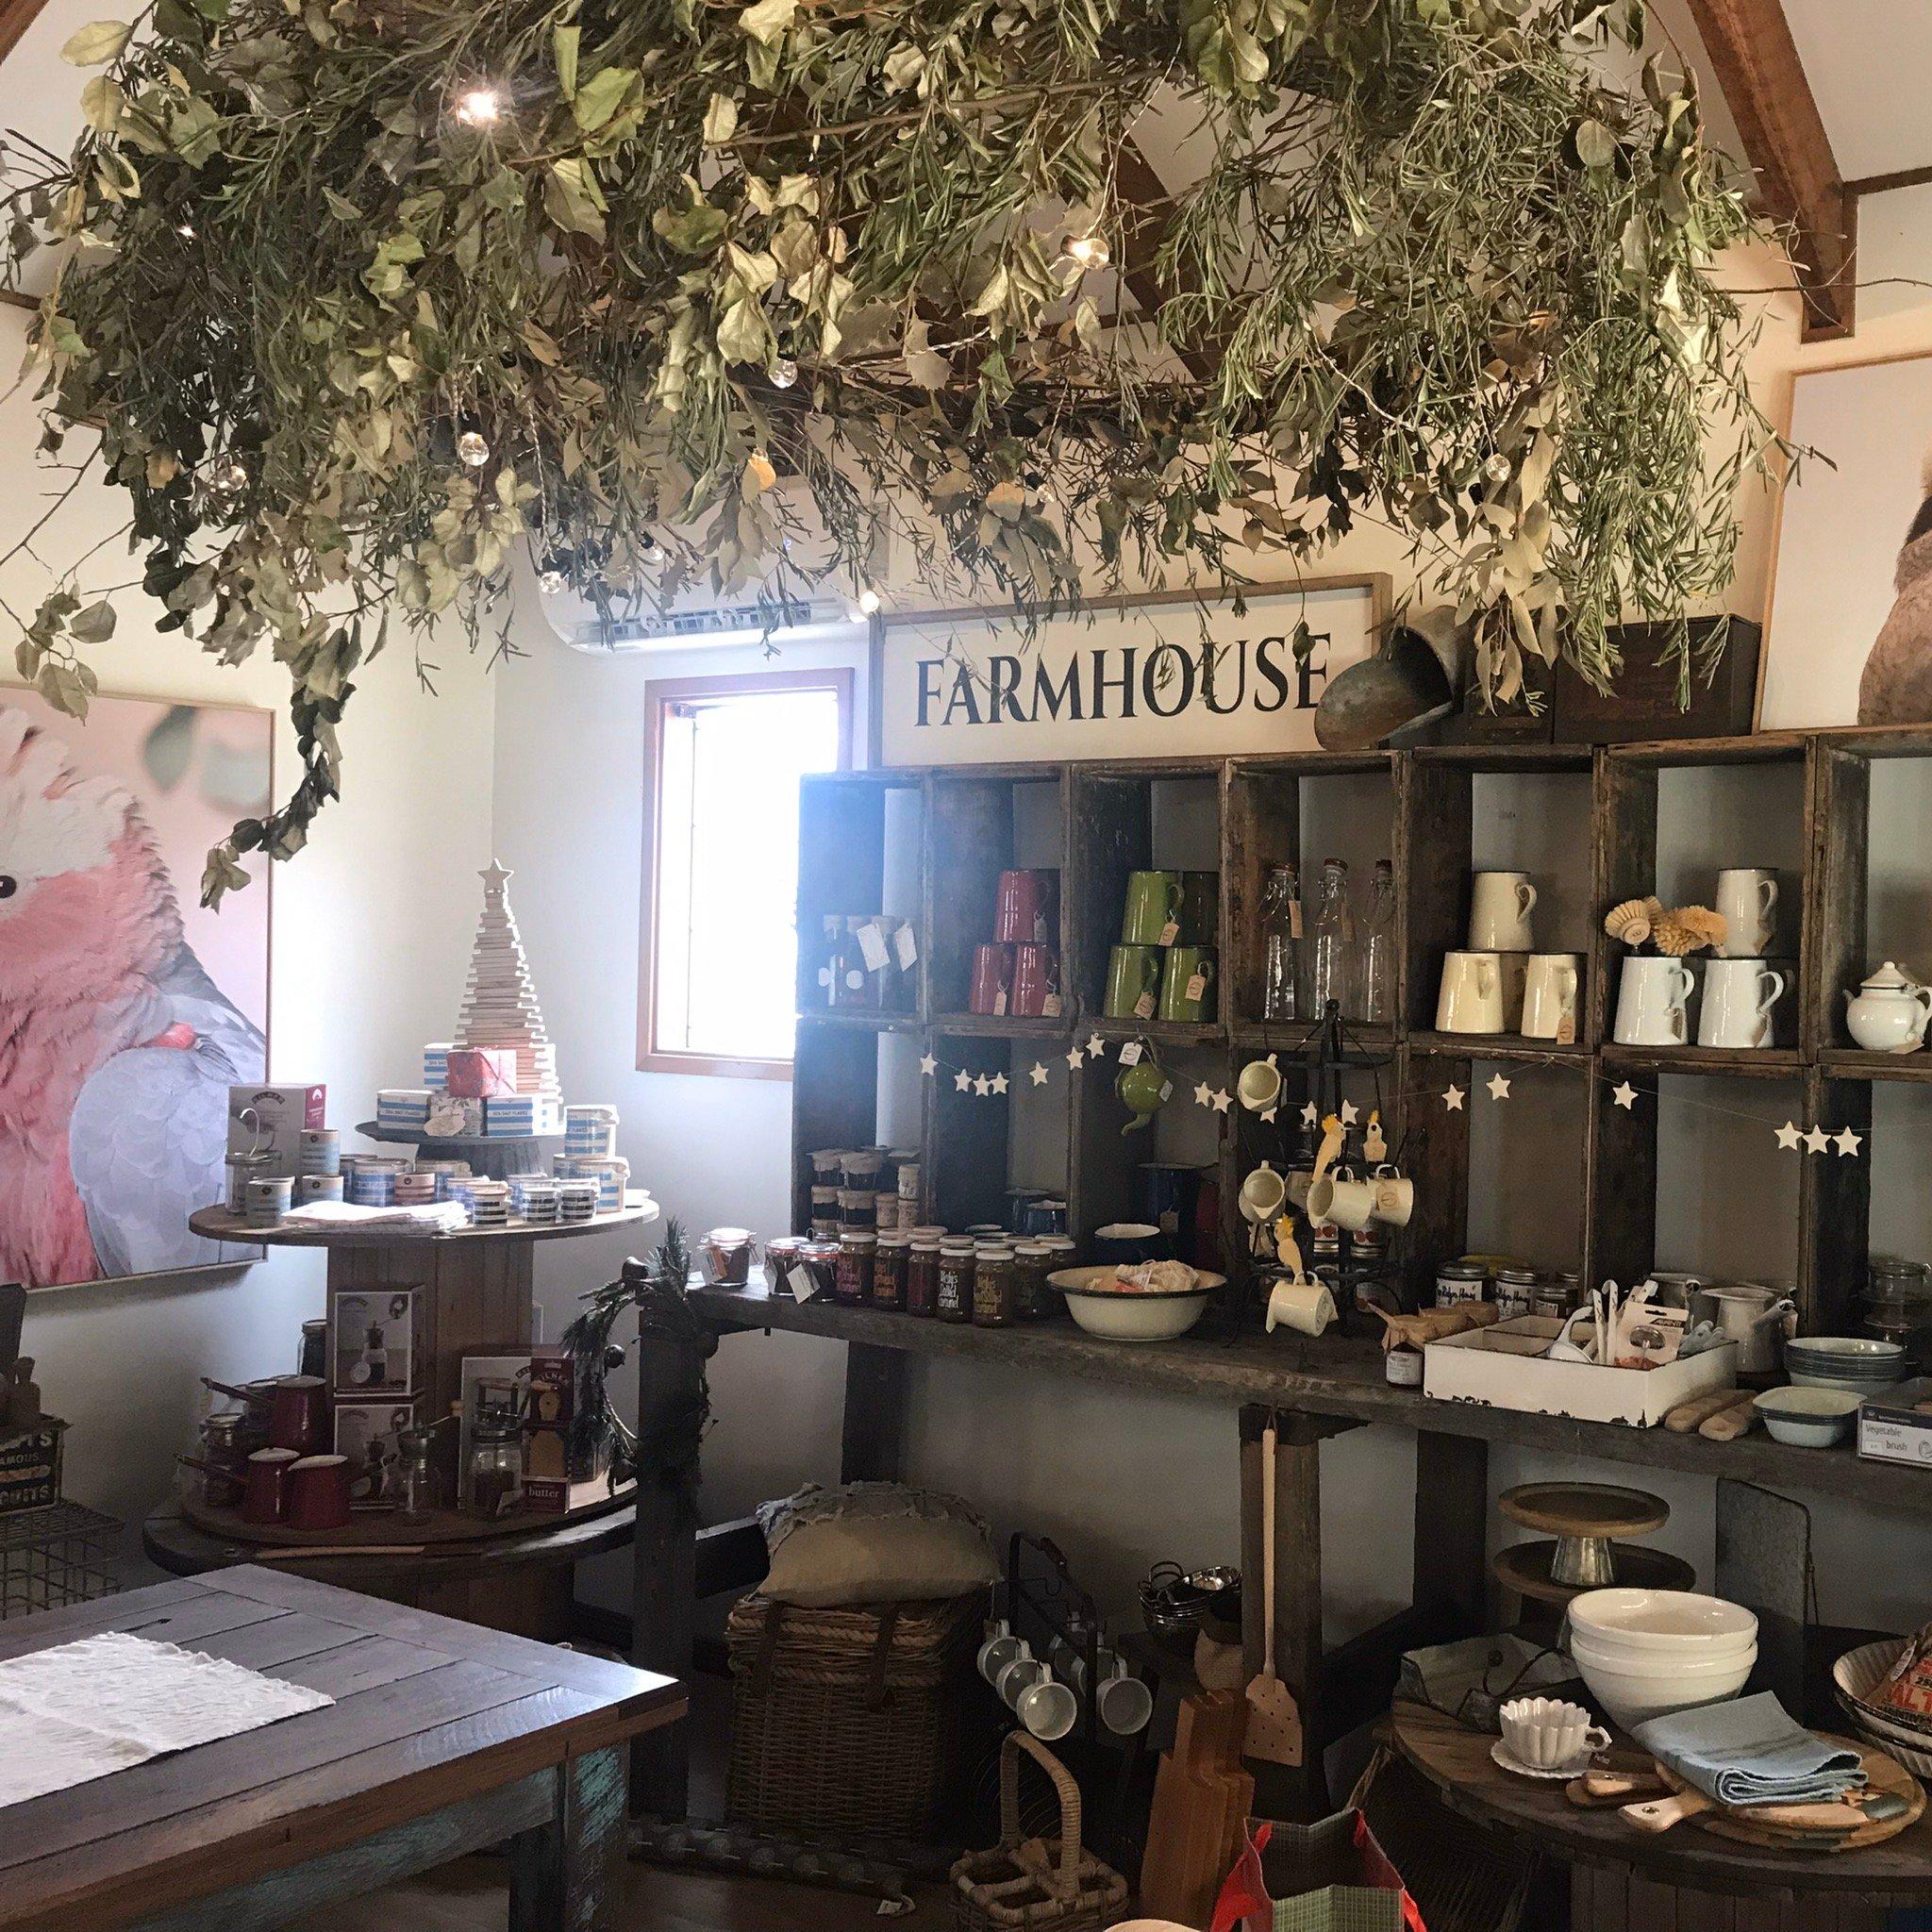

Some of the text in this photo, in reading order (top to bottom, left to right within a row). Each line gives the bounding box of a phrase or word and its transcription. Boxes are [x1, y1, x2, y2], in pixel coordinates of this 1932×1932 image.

[914, 632, 1332, 726] FARMHOUSE
[1865, 1424, 1903, 1437] Vegetable
[1886, 1440, 1907, 1451] brush
[528, 1486, 559, 1498] butter
